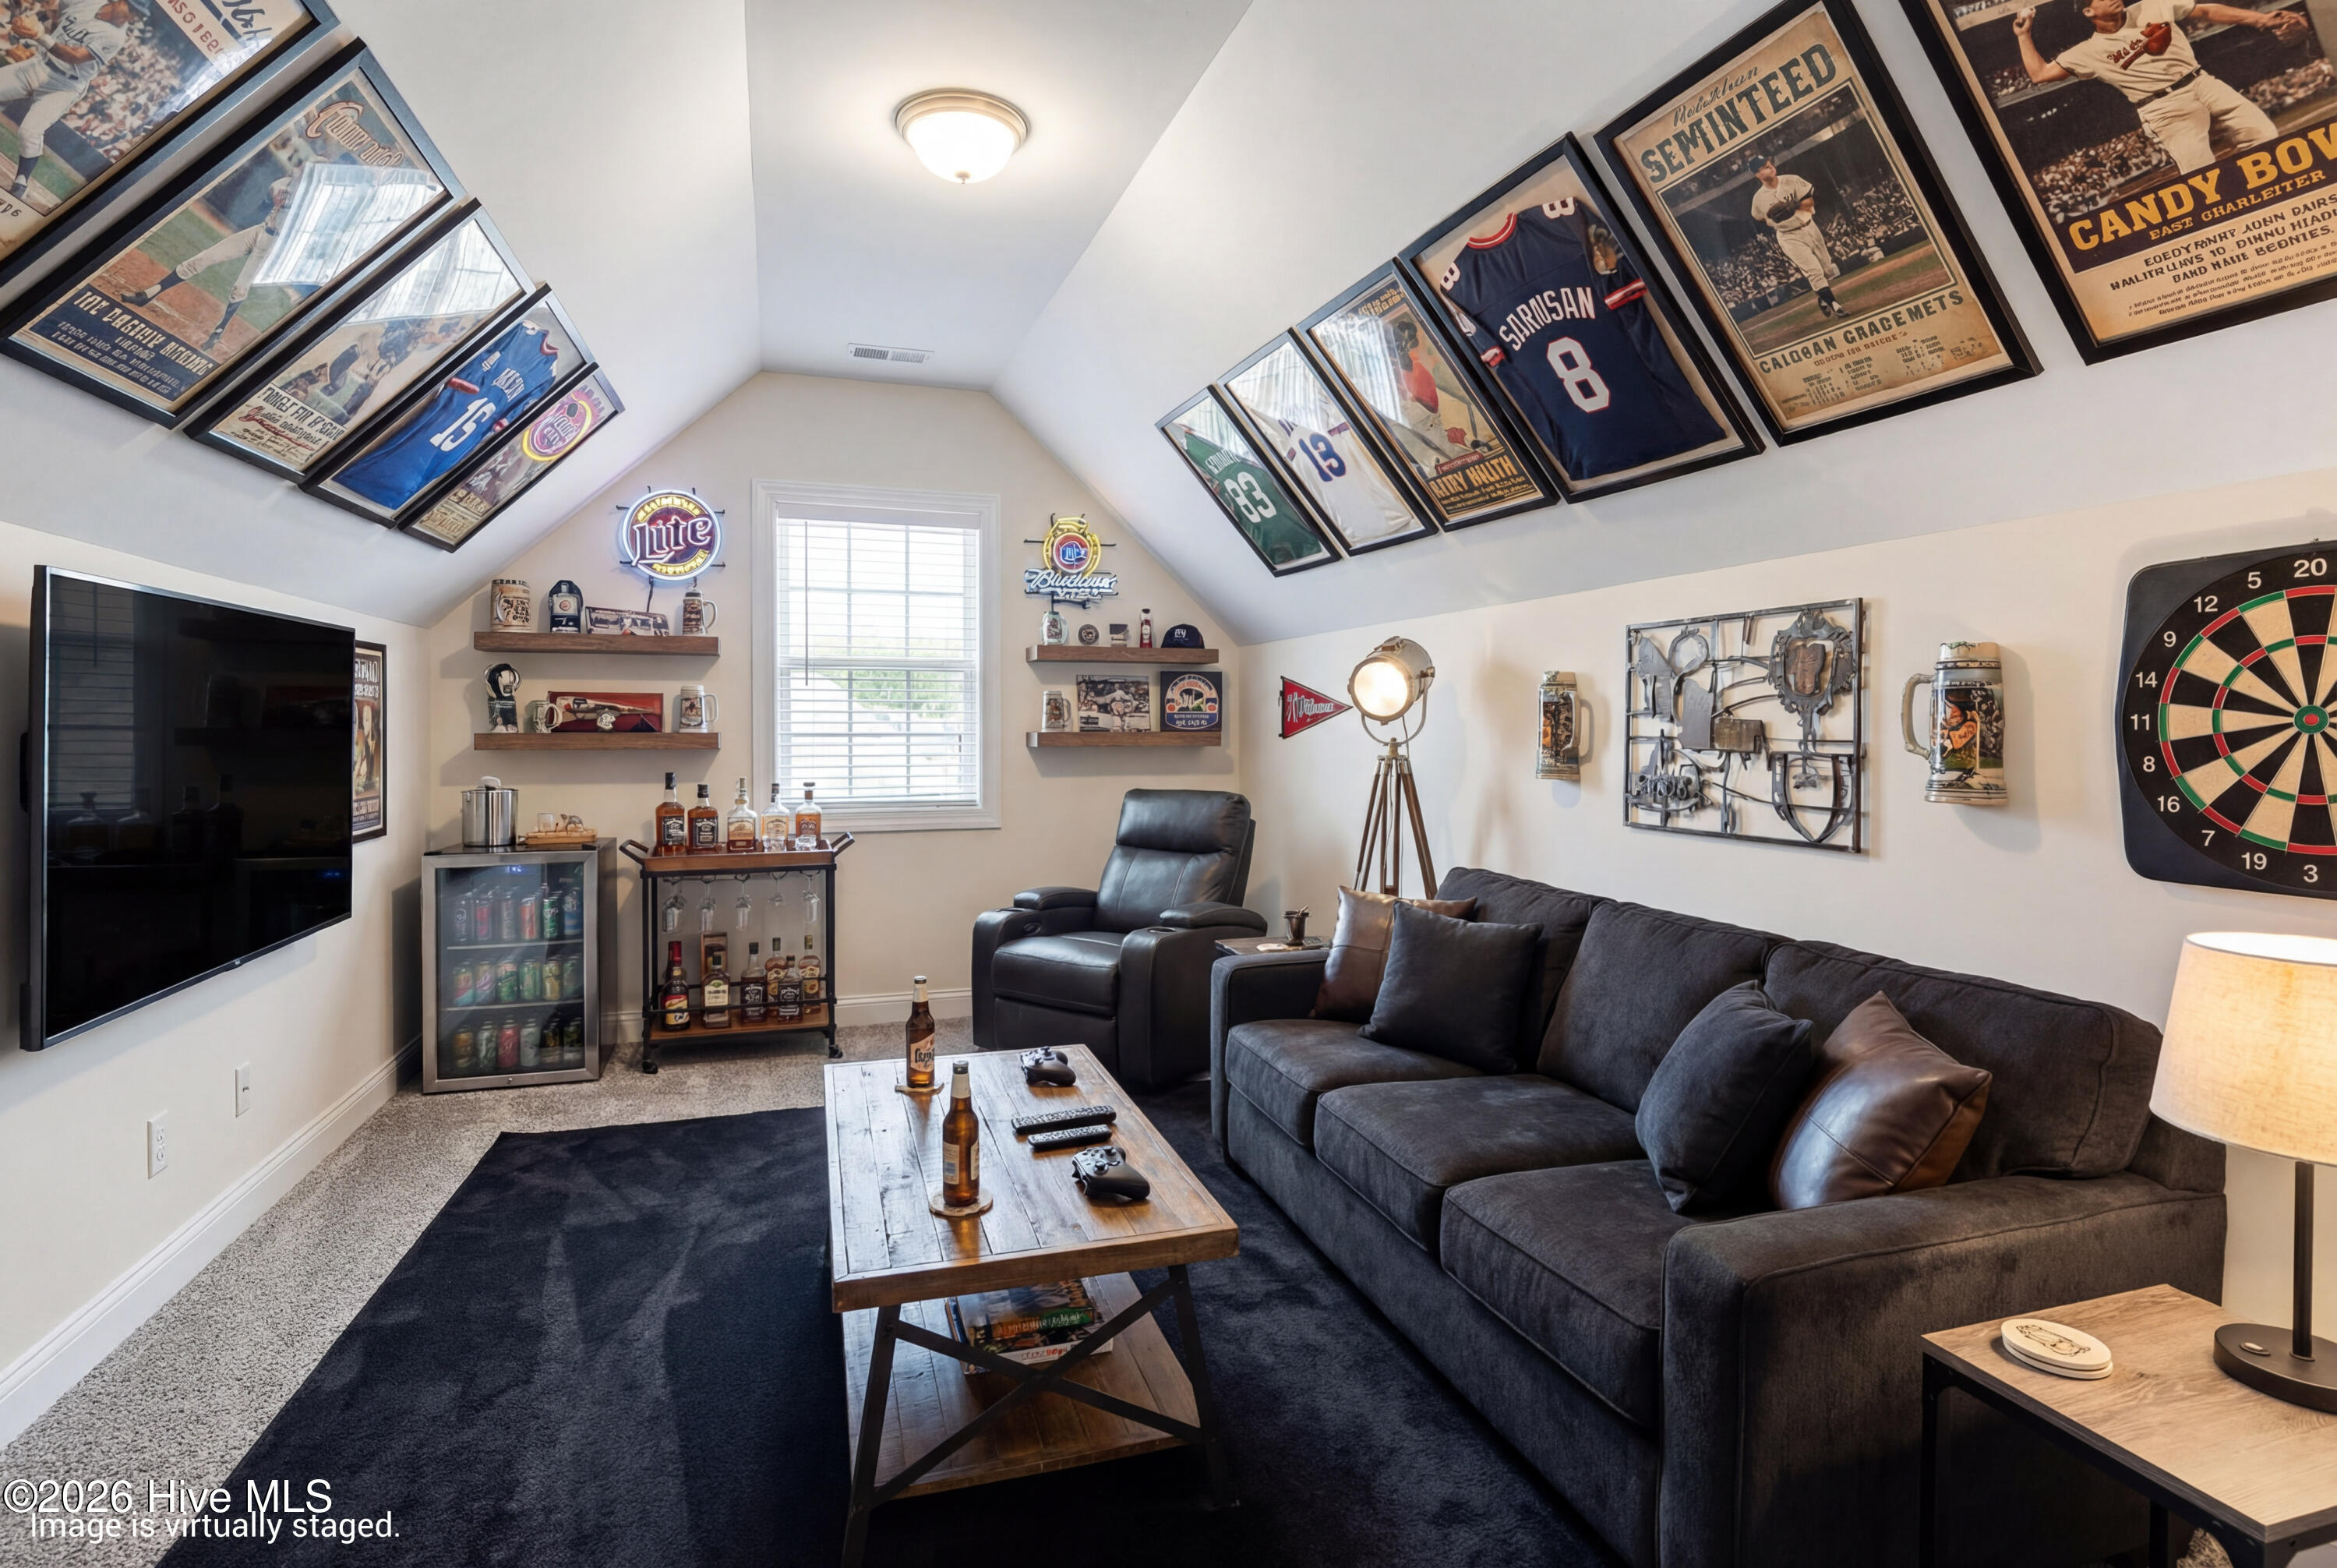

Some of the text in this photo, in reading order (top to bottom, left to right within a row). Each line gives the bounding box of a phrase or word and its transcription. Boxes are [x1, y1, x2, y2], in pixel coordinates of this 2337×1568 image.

[2069, 168, 2222, 250] CANDY
[2149, 216, 2194, 241] EAST
[1546, 336, 1611, 414] 8
[429, 397, 496, 452] 15
[1298, 432, 1347, 482] 13
[631, 514, 712, 567] Lite
[2293, 559, 2328, 577] 20
[2247, 571, 2261, 589] 5
[2194, 596, 2219, 613] 12
[2163, 630, 2176, 648] 9
[2135, 671, 2158, 688] 14
[2130, 714, 2151, 730] 11
[2143, 756, 2155, 772] 8
[2157, 795, 2180, 813] 16
[2201, 830, 2215, 846] 7
[2241, 852, 2267, 870] 19
[2303, 864, 2318, 883] 3
